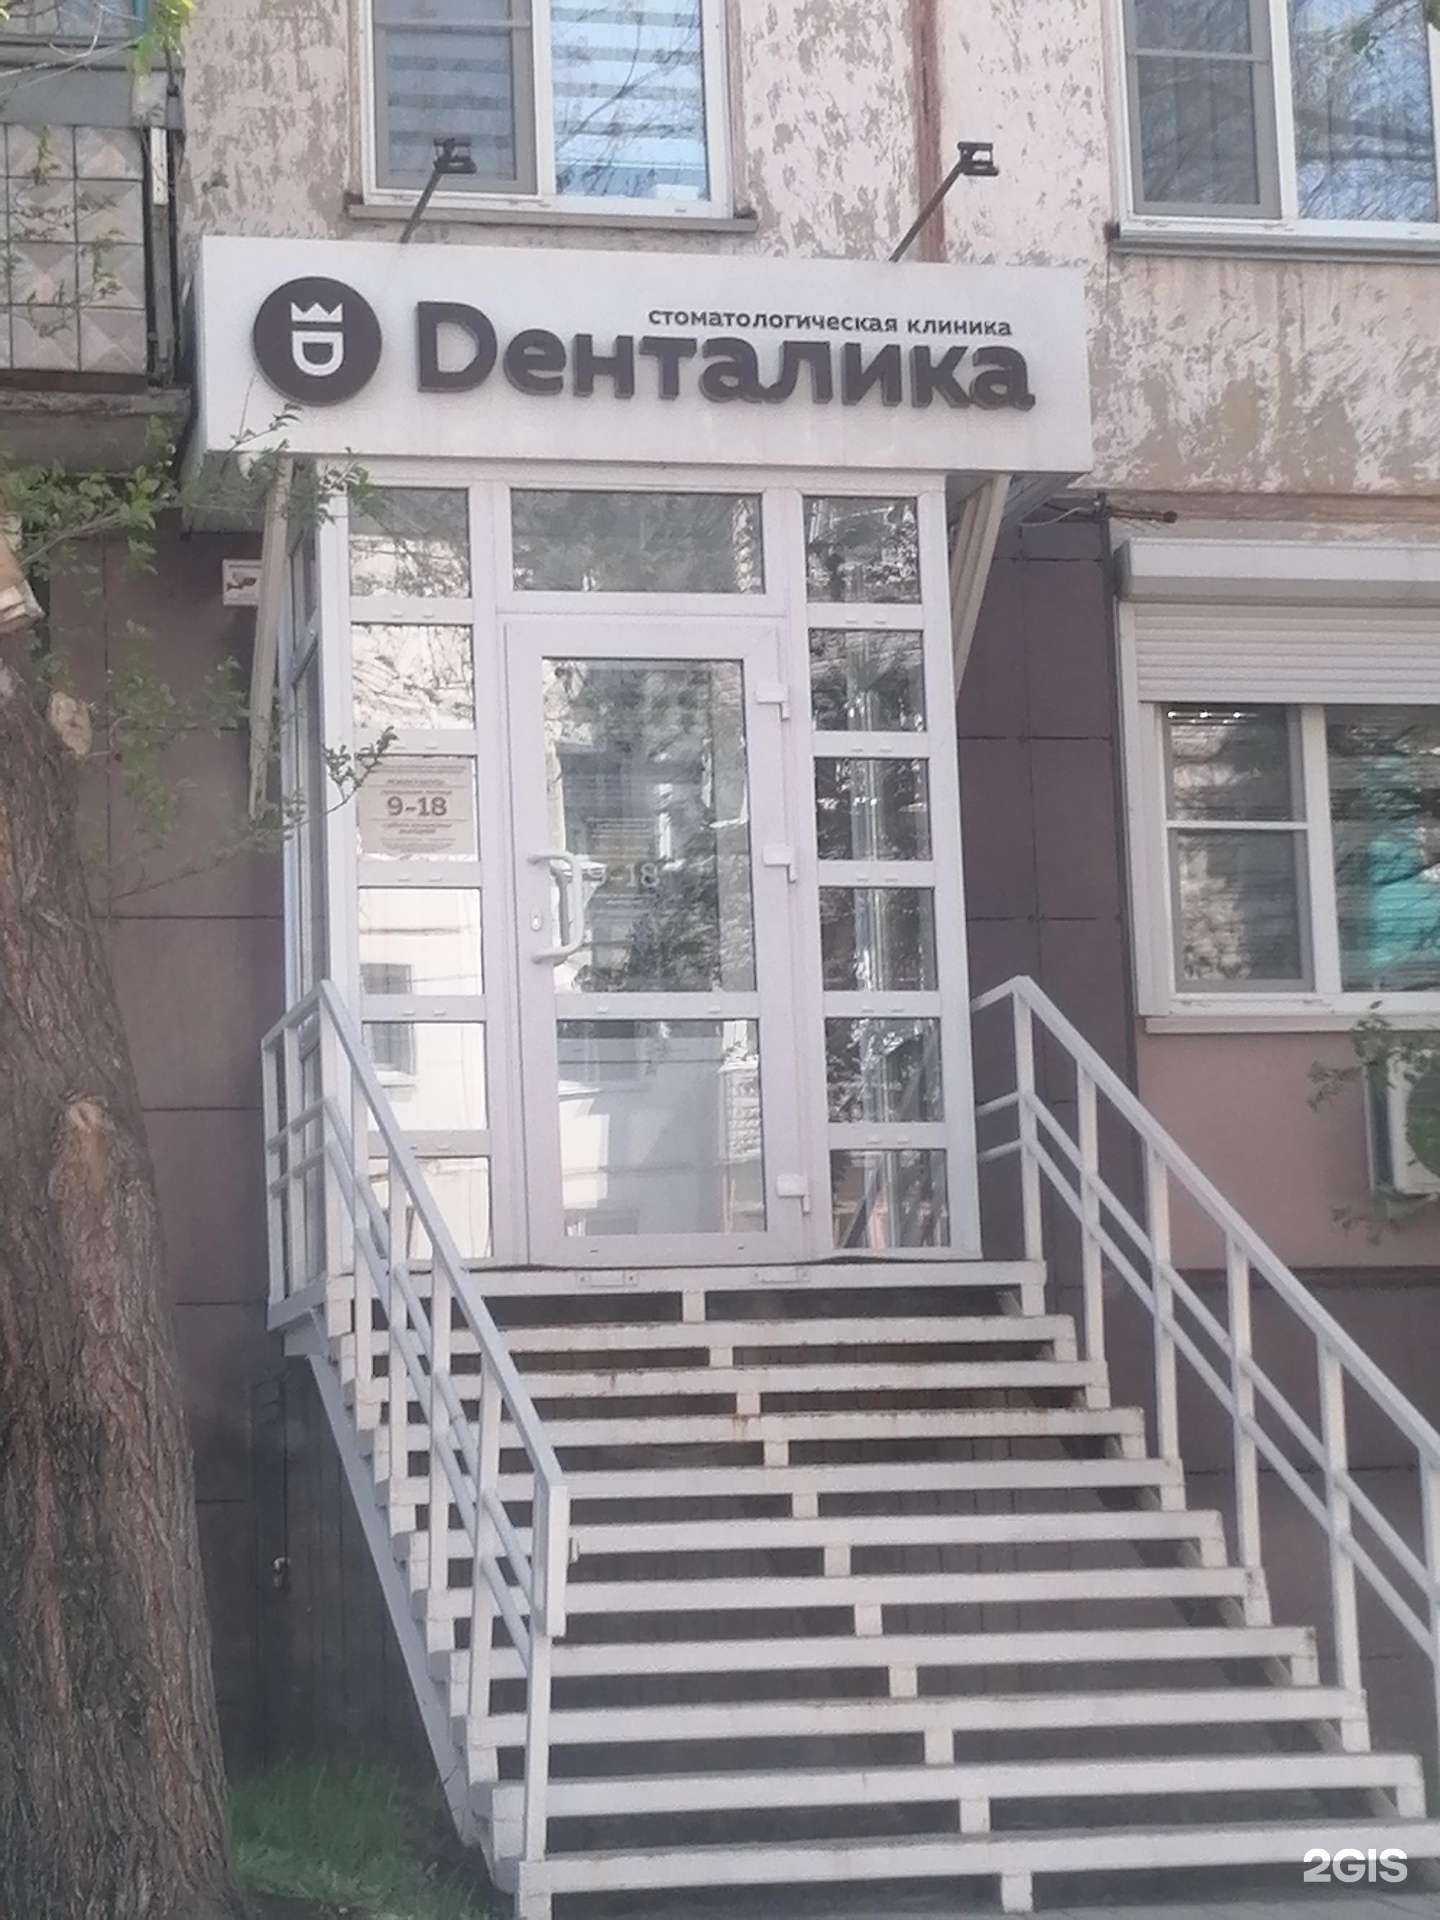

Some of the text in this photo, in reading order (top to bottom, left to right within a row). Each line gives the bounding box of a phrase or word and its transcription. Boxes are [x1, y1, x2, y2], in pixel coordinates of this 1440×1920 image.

[648, 309, 1012, 336] стоматологическая клиника
[386, 796, 448, 817] 9-18
